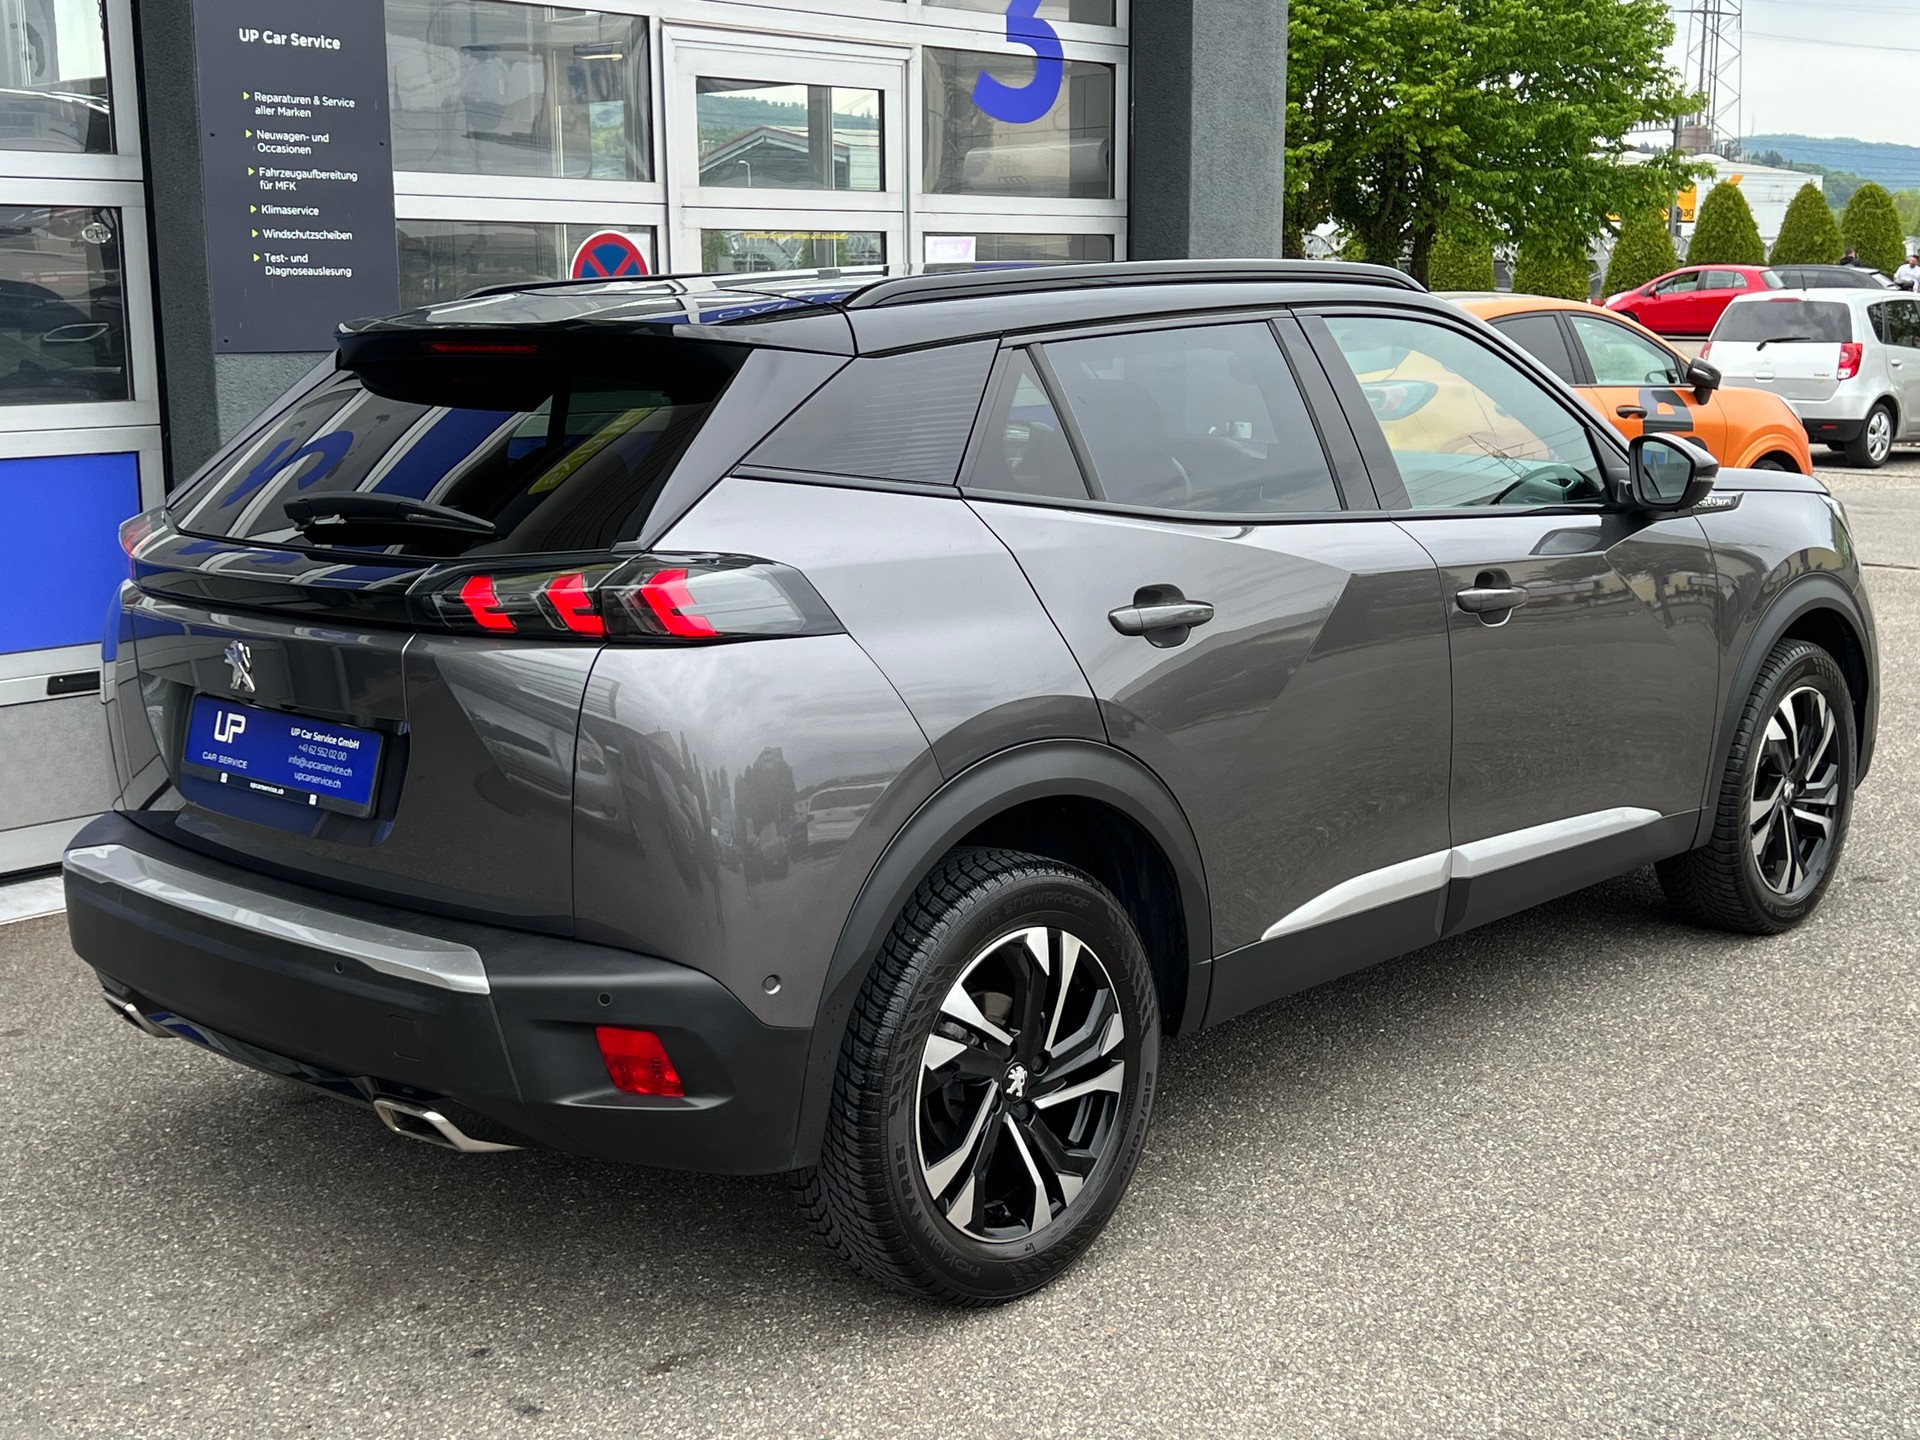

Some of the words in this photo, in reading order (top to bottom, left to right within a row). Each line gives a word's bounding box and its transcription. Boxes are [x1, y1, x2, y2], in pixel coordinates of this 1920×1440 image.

[238, 28, 259, 42] UP
[262, 31, 287, 45] Car
[290, 33, 342, 50] Service
[972, 0, 1064, 124] 3
[254, 92, 311, 105] Reparaturen
[313, 96, 320, 105] &
[322, 96, 356, 108] Service
[255, 105, 275, 115] aller
[277, 107, 311, 118] Marken
[256, 130, 310, 142] Neuwagen-
[311, 133, 330, 143] und
[257, 143, 312, 155] Occasionen
[258, 167, 358, 182] Fahrzeugaufbereitung
[259, 180, 274, 190] für
[275, 181, 297, 191] MFK
[261, 204, 320, 216] Klimaservice
[262, 229, 353, 241] Windschutzscheiben
[264, 252, 289, 263] Test-
[290, 253, 309, 264] und
[265, 266, 352, 278] Diagnoseauslesung
[214, 711, 246, 743] UP
[290, 727, 301, 737] UP
[301, 730, 313, 740] Car
[312, 732, 337, 744] Service
[337, 737, 360, 750] GmbH
[308, 745, 317, 755] 62
[202, 751, 217, 761] CAR
[218, 755, 248, 769] SERVICE
[293, 772, 342, 789] upcarservice.ch
